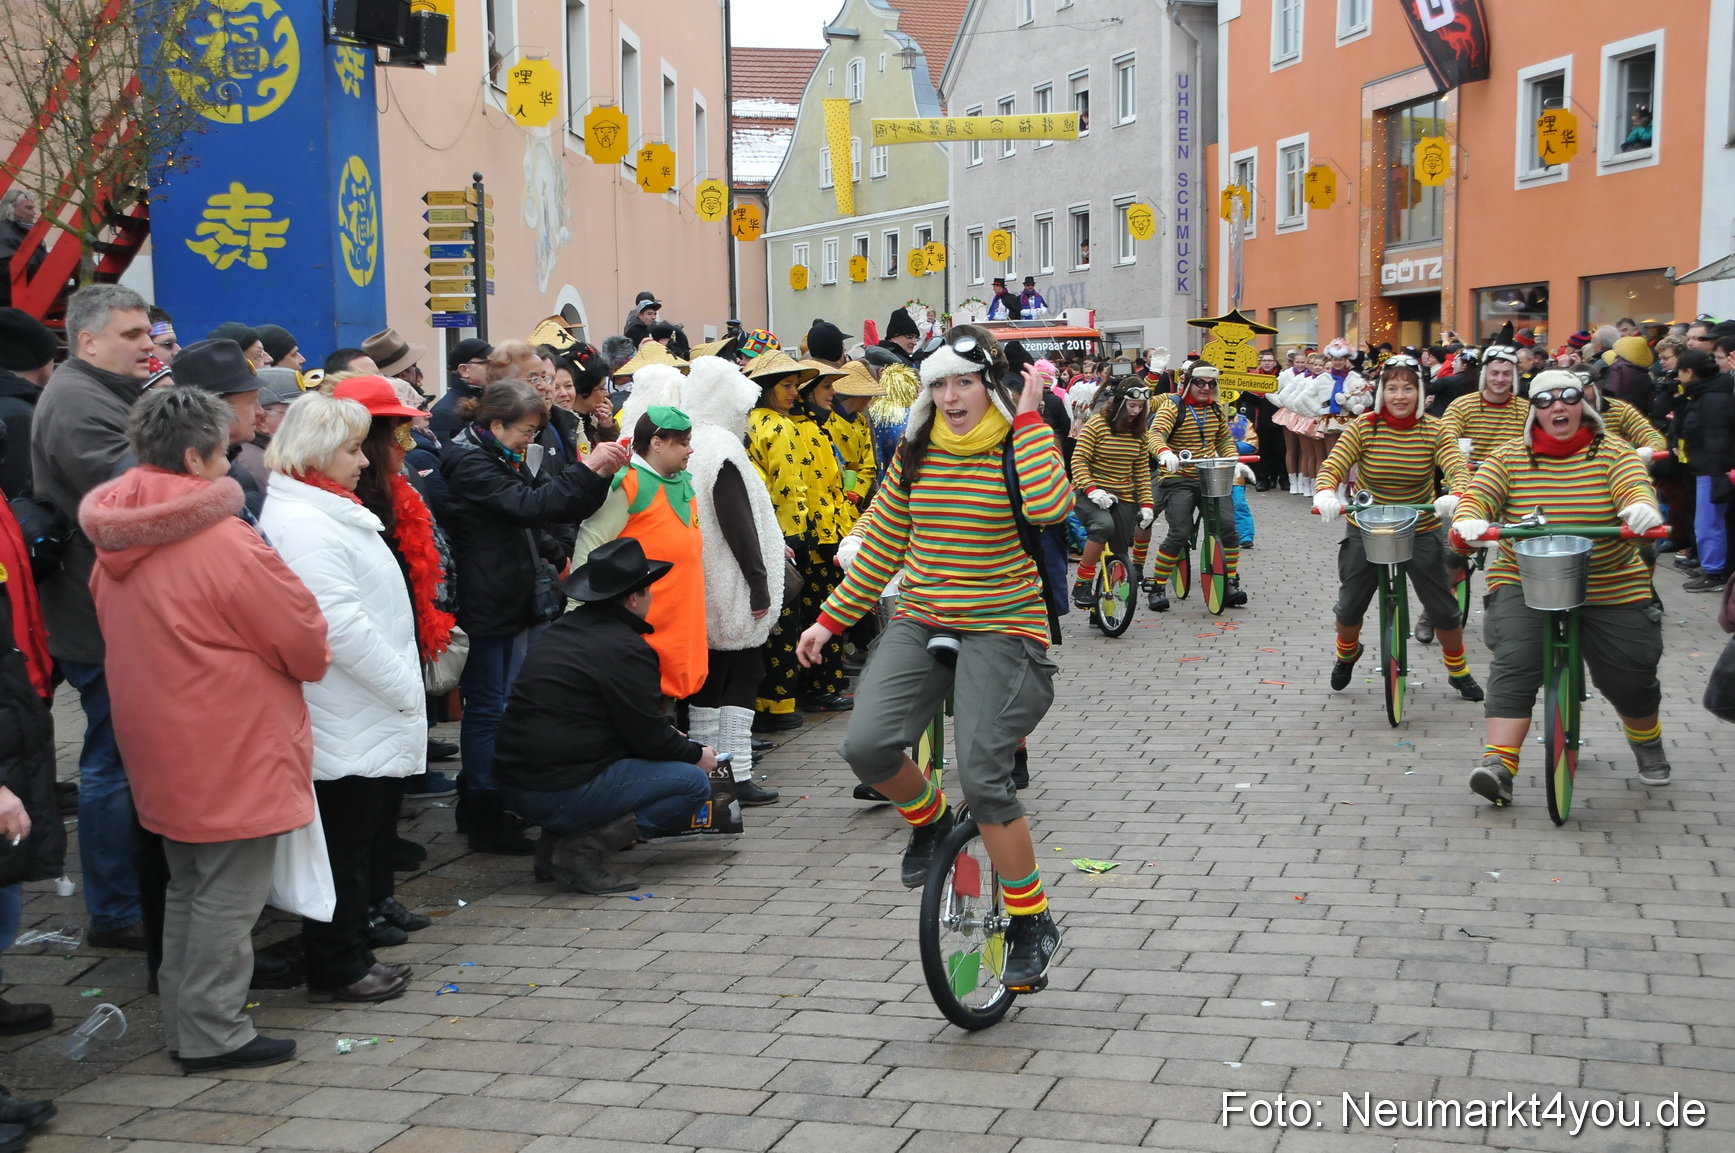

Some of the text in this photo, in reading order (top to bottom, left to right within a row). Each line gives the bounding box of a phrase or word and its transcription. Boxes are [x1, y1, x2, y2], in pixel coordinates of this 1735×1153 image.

[1178, 74, 1189, 160] UHREN
[1176, 172, 1190, 291] SCHMUCK
[1381, 258, 1442, 285] GÖTZ
[1067, 340, 1092, 351] 2015
[1237, 378, 1275, 390] Denkendorf
[1220, 391, 1233, 400] 43
